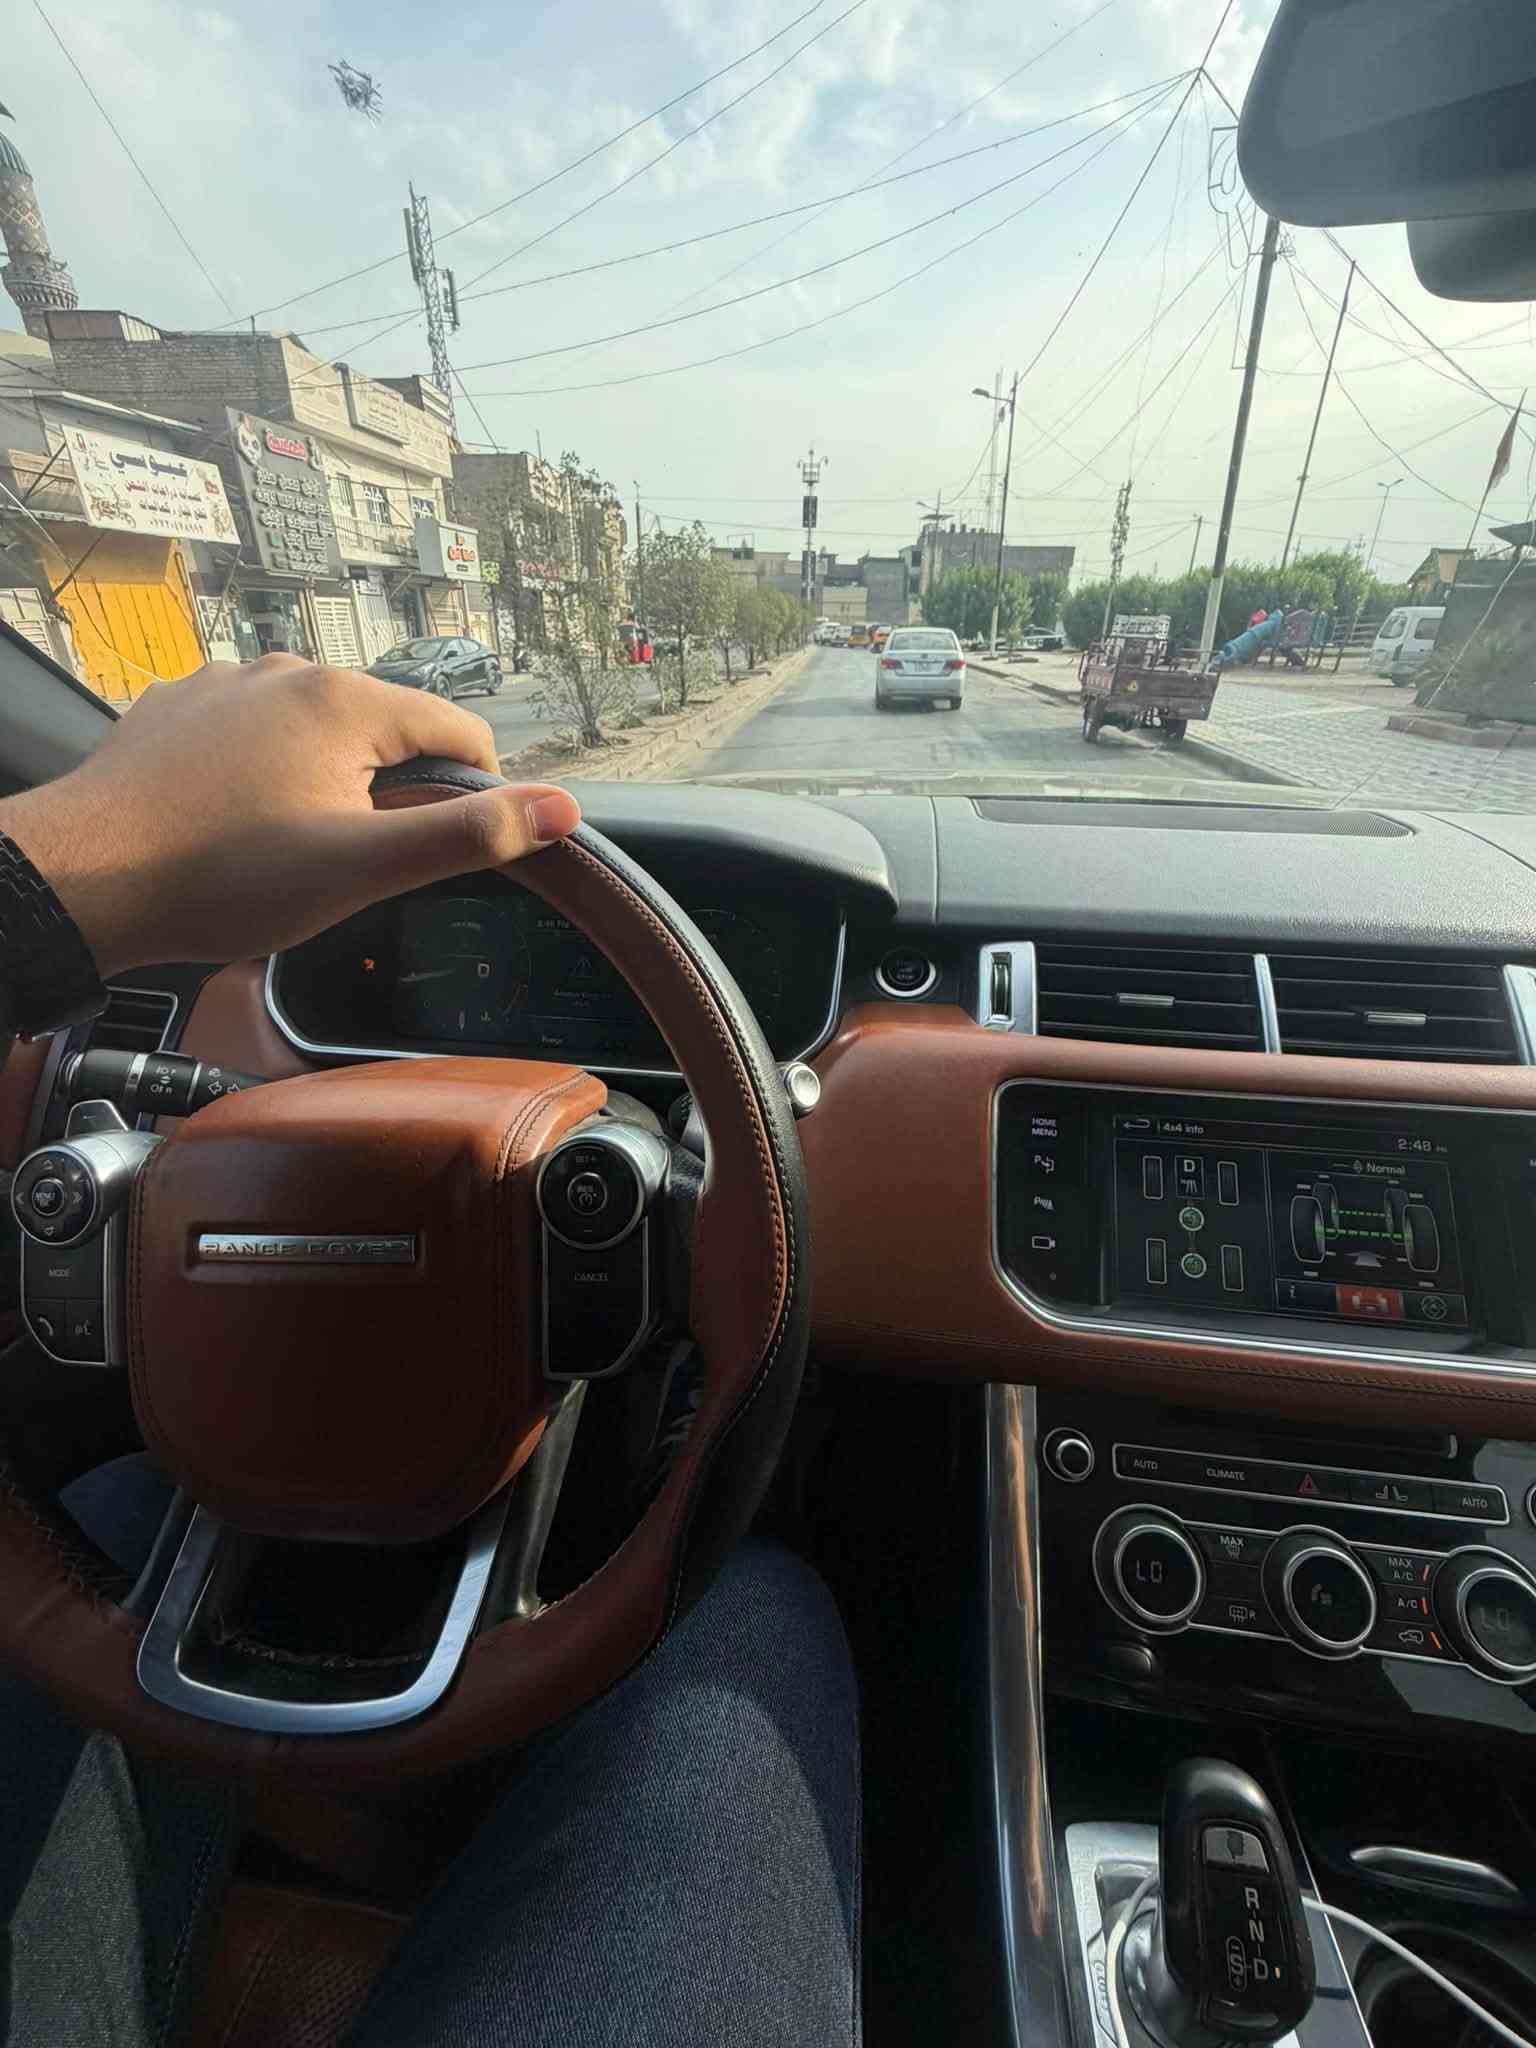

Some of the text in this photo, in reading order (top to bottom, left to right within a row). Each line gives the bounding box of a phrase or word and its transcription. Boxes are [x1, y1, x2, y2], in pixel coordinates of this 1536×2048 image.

[1031, 1118, 1057, 1128] HOME
[1031, 1127, 1058, 1137] MENU
[1366, 1162, 1406, 1175] Normal
[201, 1241, 297, 1256] RANGE
[1133, 1458, 1159, 1471] AUTO
[1206, 1467, 1247, 1482] CLIMATE
[1461, 1497, 1489, 1509] AUTO
[1220, 1535, 1245, 1547] MAX
[1388, 1556, 1414, 1570] MAX
[1398, 1598, 1418, 1609] A/C
[1244, 1887, 1260, 1909] R
[1248, 1919, 1265, 1943] N
[1252, 1956, 1269, 1980] D
